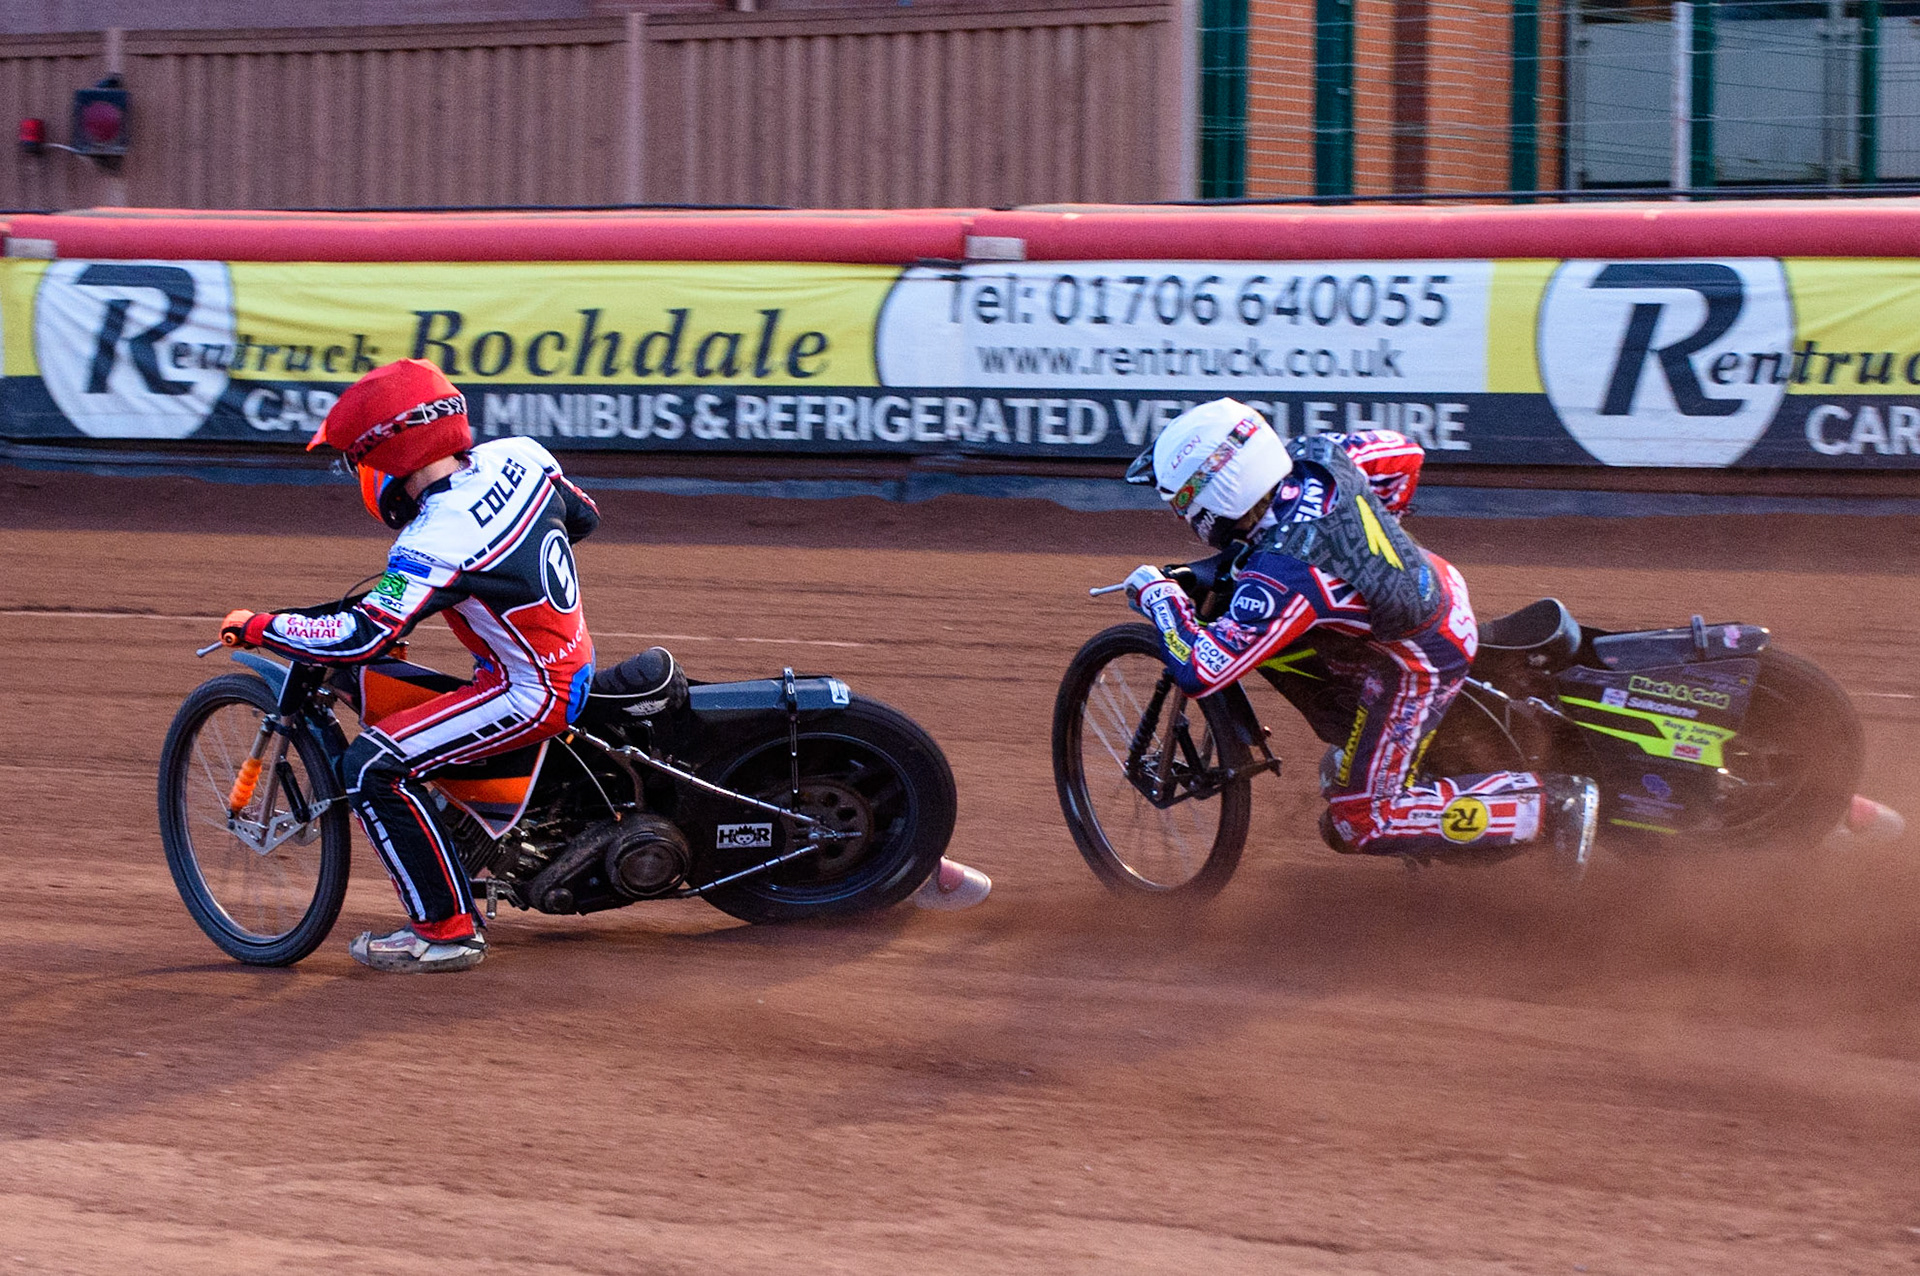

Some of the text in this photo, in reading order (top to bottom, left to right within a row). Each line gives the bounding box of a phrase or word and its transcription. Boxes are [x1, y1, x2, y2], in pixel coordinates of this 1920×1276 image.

[939, 273, 1449, 328] Tel: 01706 640055
[75, 264, 829, 394] Rentruck Rochdale
[975, 337, 1404, 380] www.rentruck.co.uk
[482, 392, 685, 440] MINIBUS
[691, 393, 731, 440] &
[735, 394, 1108, 447] REFRIGERATED
[1344, 401, 1471, 450] HIRE
[1805, 404, 1920, 455] CAR
[1170, 434, 1202, 470] LEON
[468, 457, 528, 529] COLES
[286, 627, 341, 639] MAHAL
